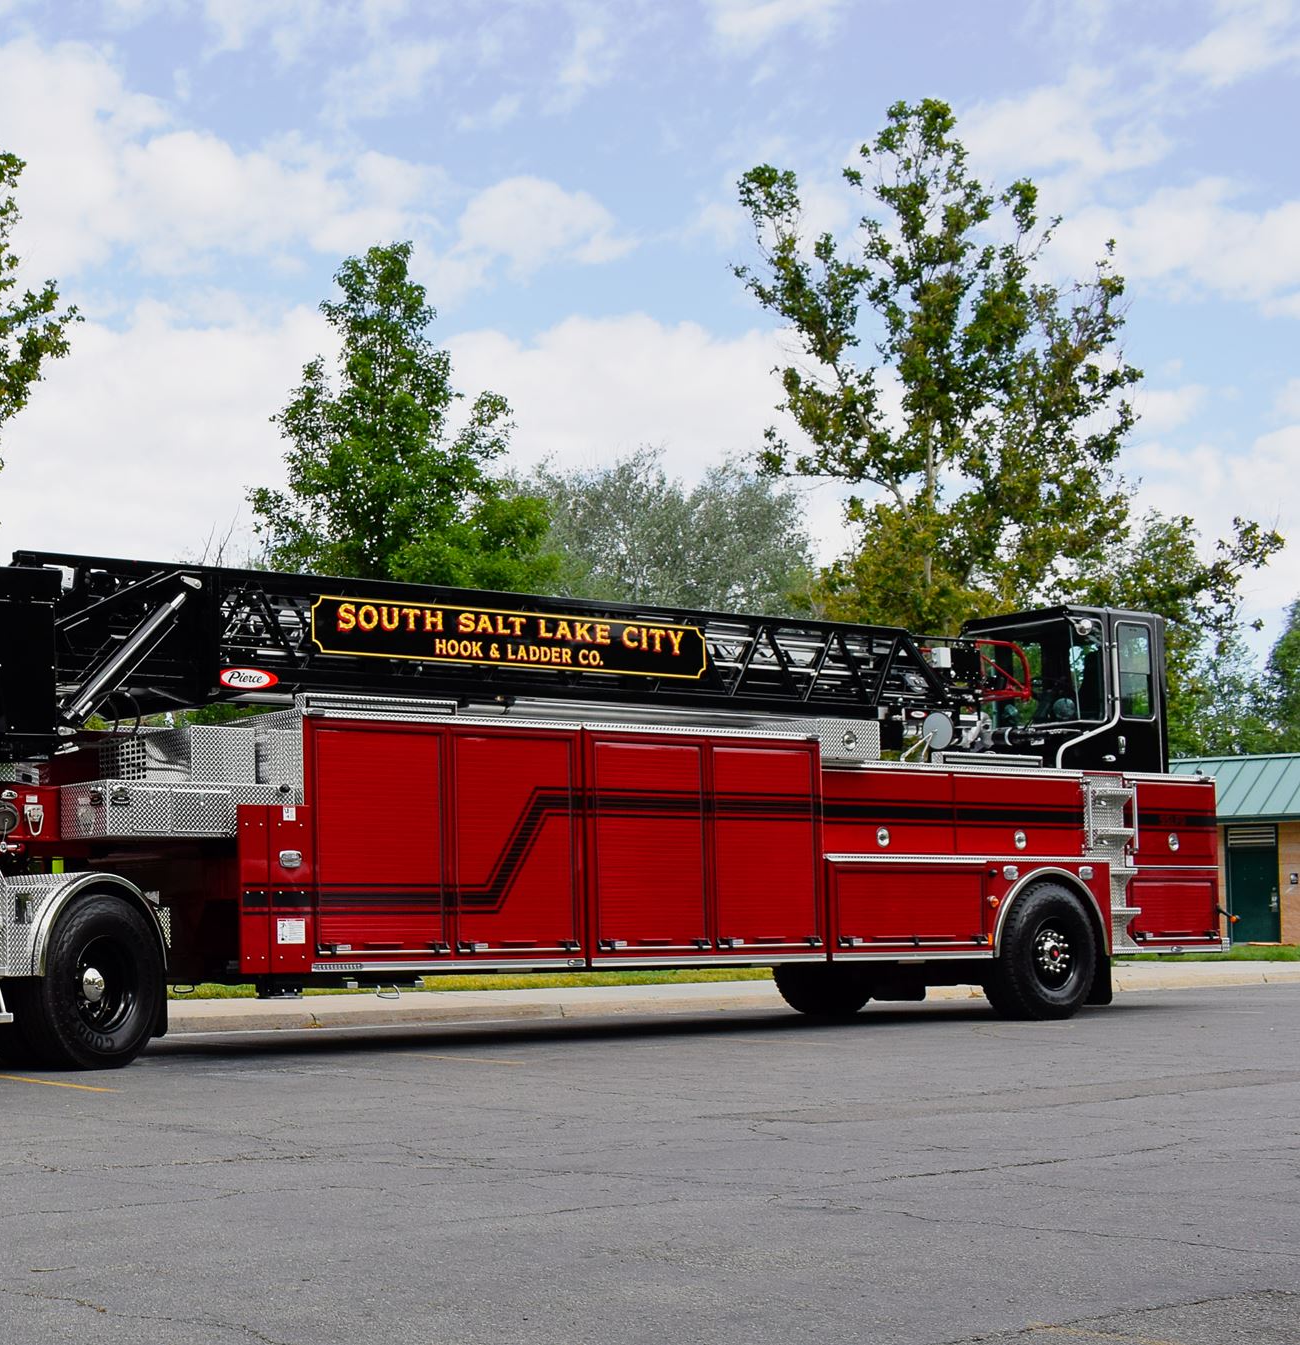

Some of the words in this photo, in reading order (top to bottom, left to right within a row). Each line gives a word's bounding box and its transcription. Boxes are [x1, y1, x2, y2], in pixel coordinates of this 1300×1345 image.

[336, 602, 444, 632] SOUTH
[457, 611, 527, 637] SALT
[537, 618, 611, 646] LAKE
[622, 625, 685, 657] CITY
[434, 637, 484, 658] HOOK
[489, 642, 501, 660] &
[506, 643, 572, 664] LADDER
[578, 649, 605, 667] CO.
[228, 670, 264, 684] Pierce
